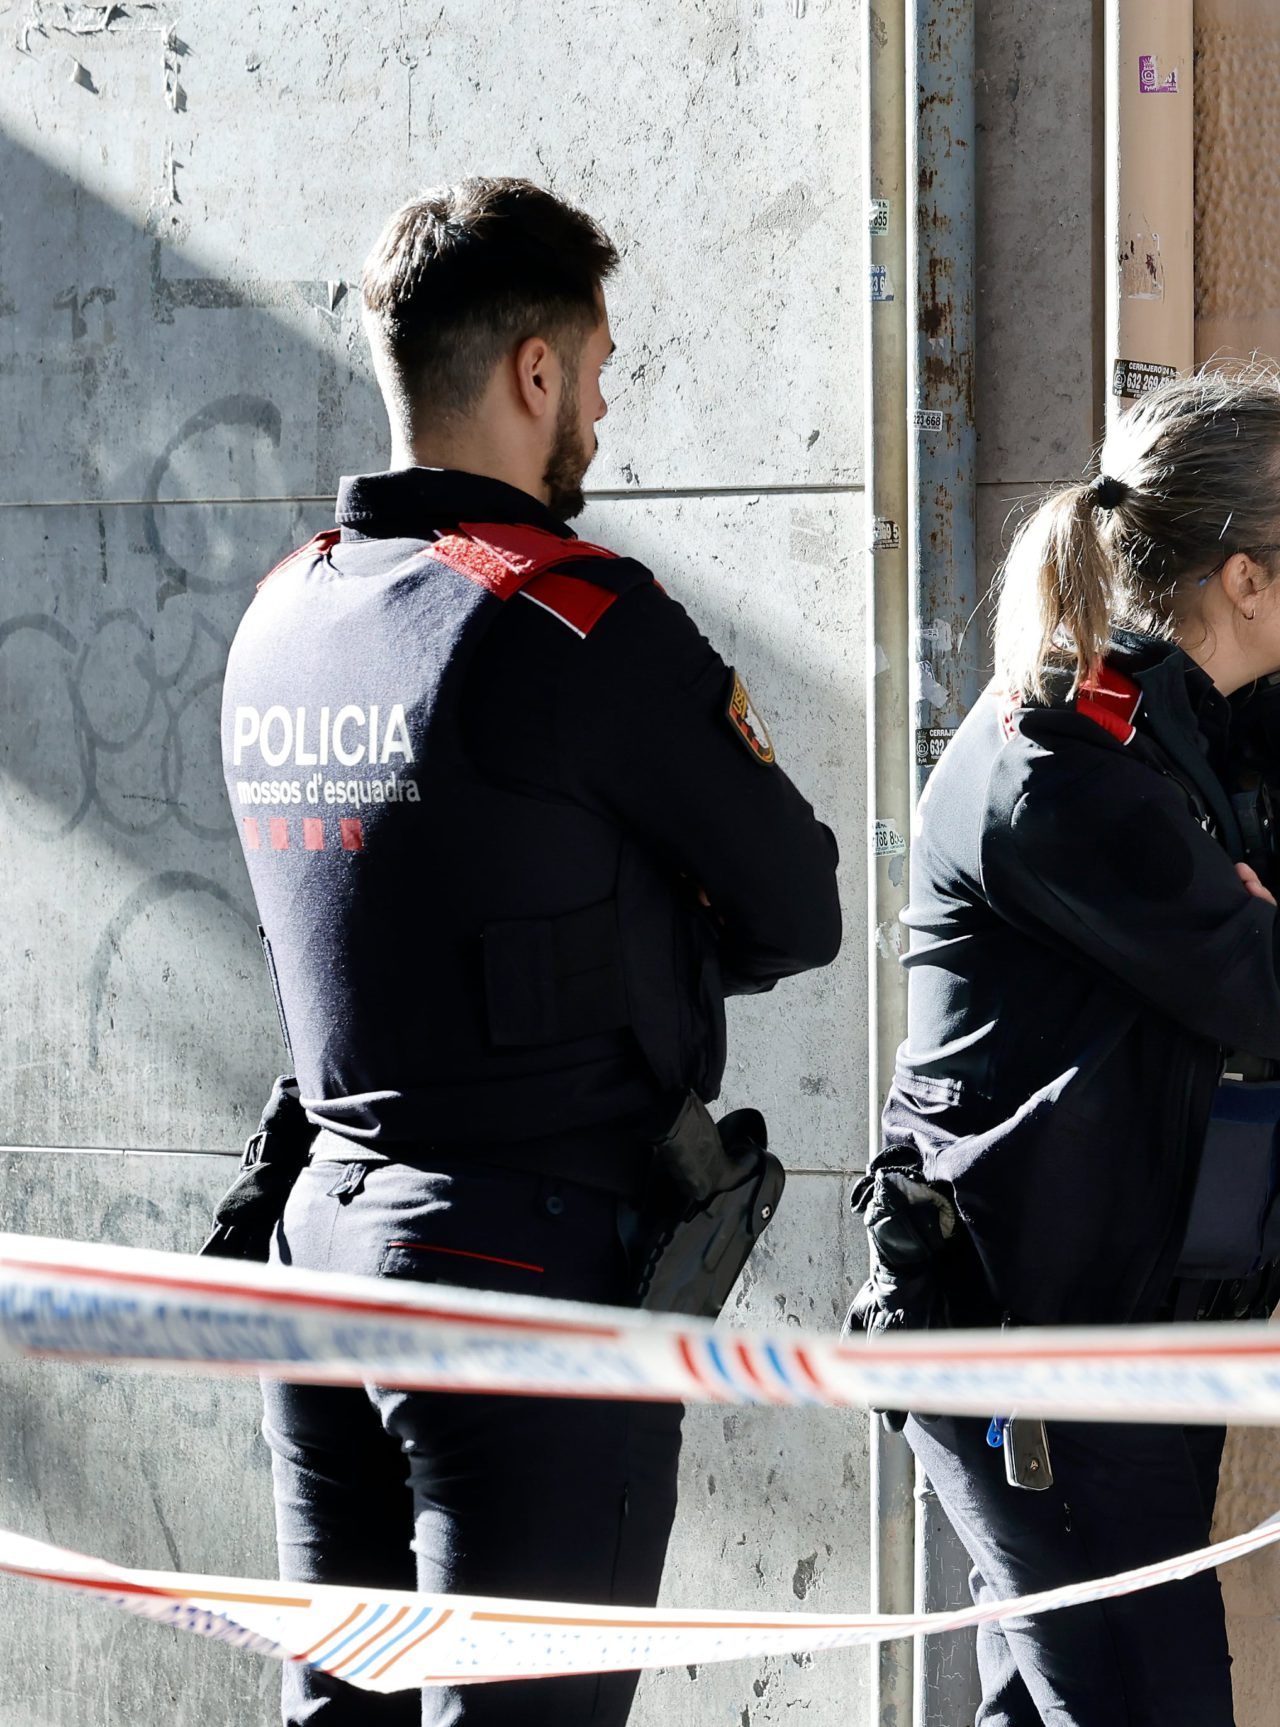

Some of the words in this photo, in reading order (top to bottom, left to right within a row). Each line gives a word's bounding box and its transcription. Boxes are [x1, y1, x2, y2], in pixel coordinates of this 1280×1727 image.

[1128, 361, 1162, 374] CERRAJERO
[1126, 372, 1142, 390] 632
[926, 415, 941, 427] 668
[233, 703, 415, 767] POLICIA
[236, 779, 301, 805] mossos
[306, 771, 422, 810] d'esquadra
